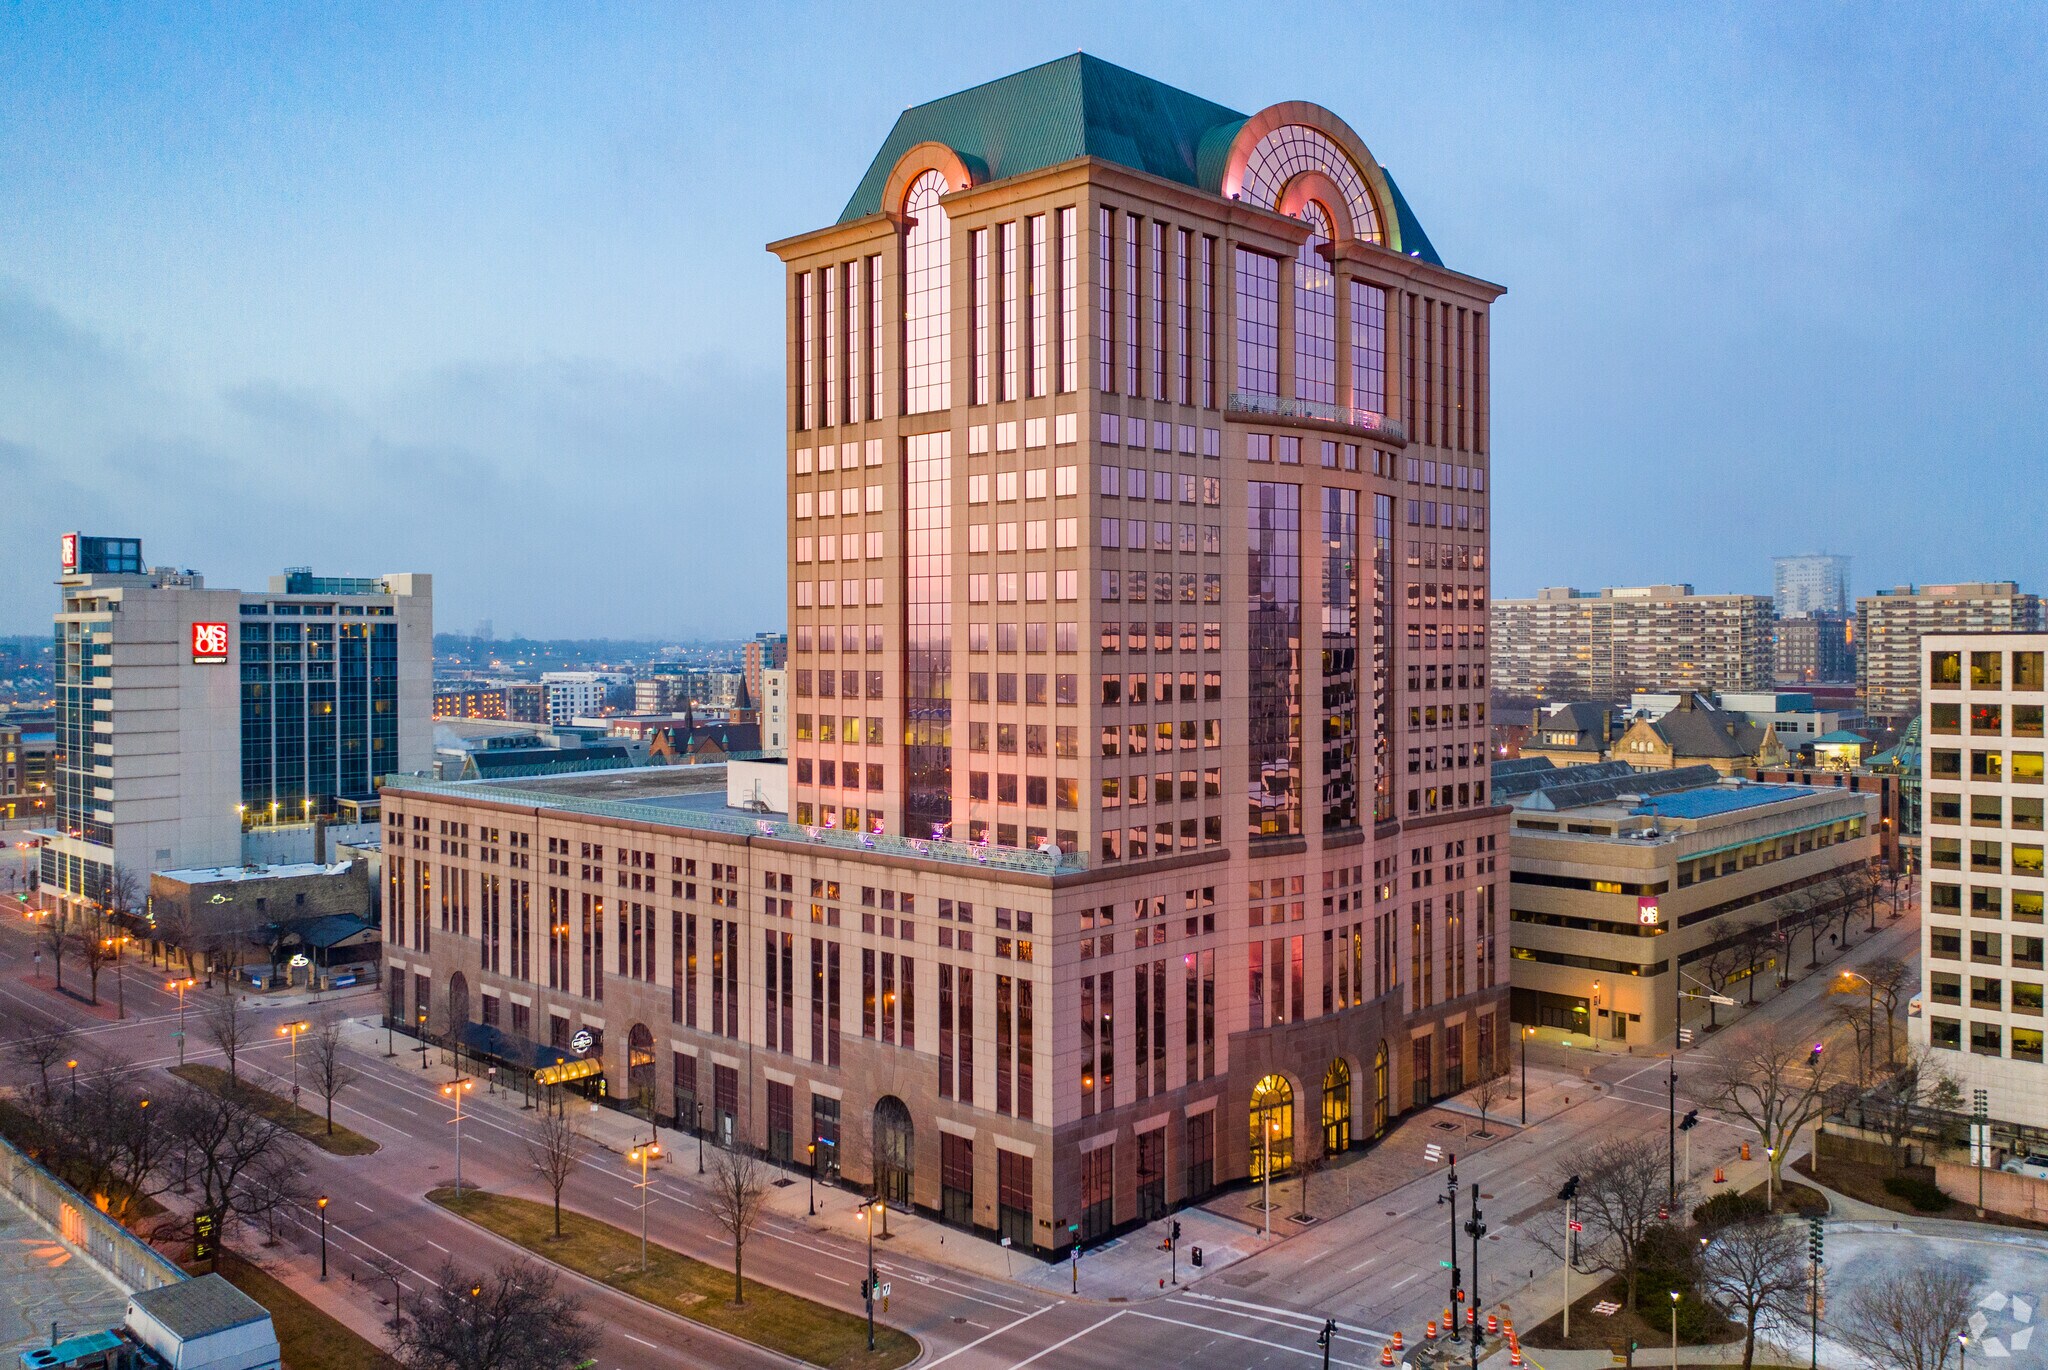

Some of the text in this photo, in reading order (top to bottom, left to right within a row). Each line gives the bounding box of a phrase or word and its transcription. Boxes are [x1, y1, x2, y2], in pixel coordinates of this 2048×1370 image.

[196, 625, 227, 641] MS
[195, 639, 227, 652] OE
[1641, 906, 1658, 916] MS
[1640, 915, 1658, 924] OE
